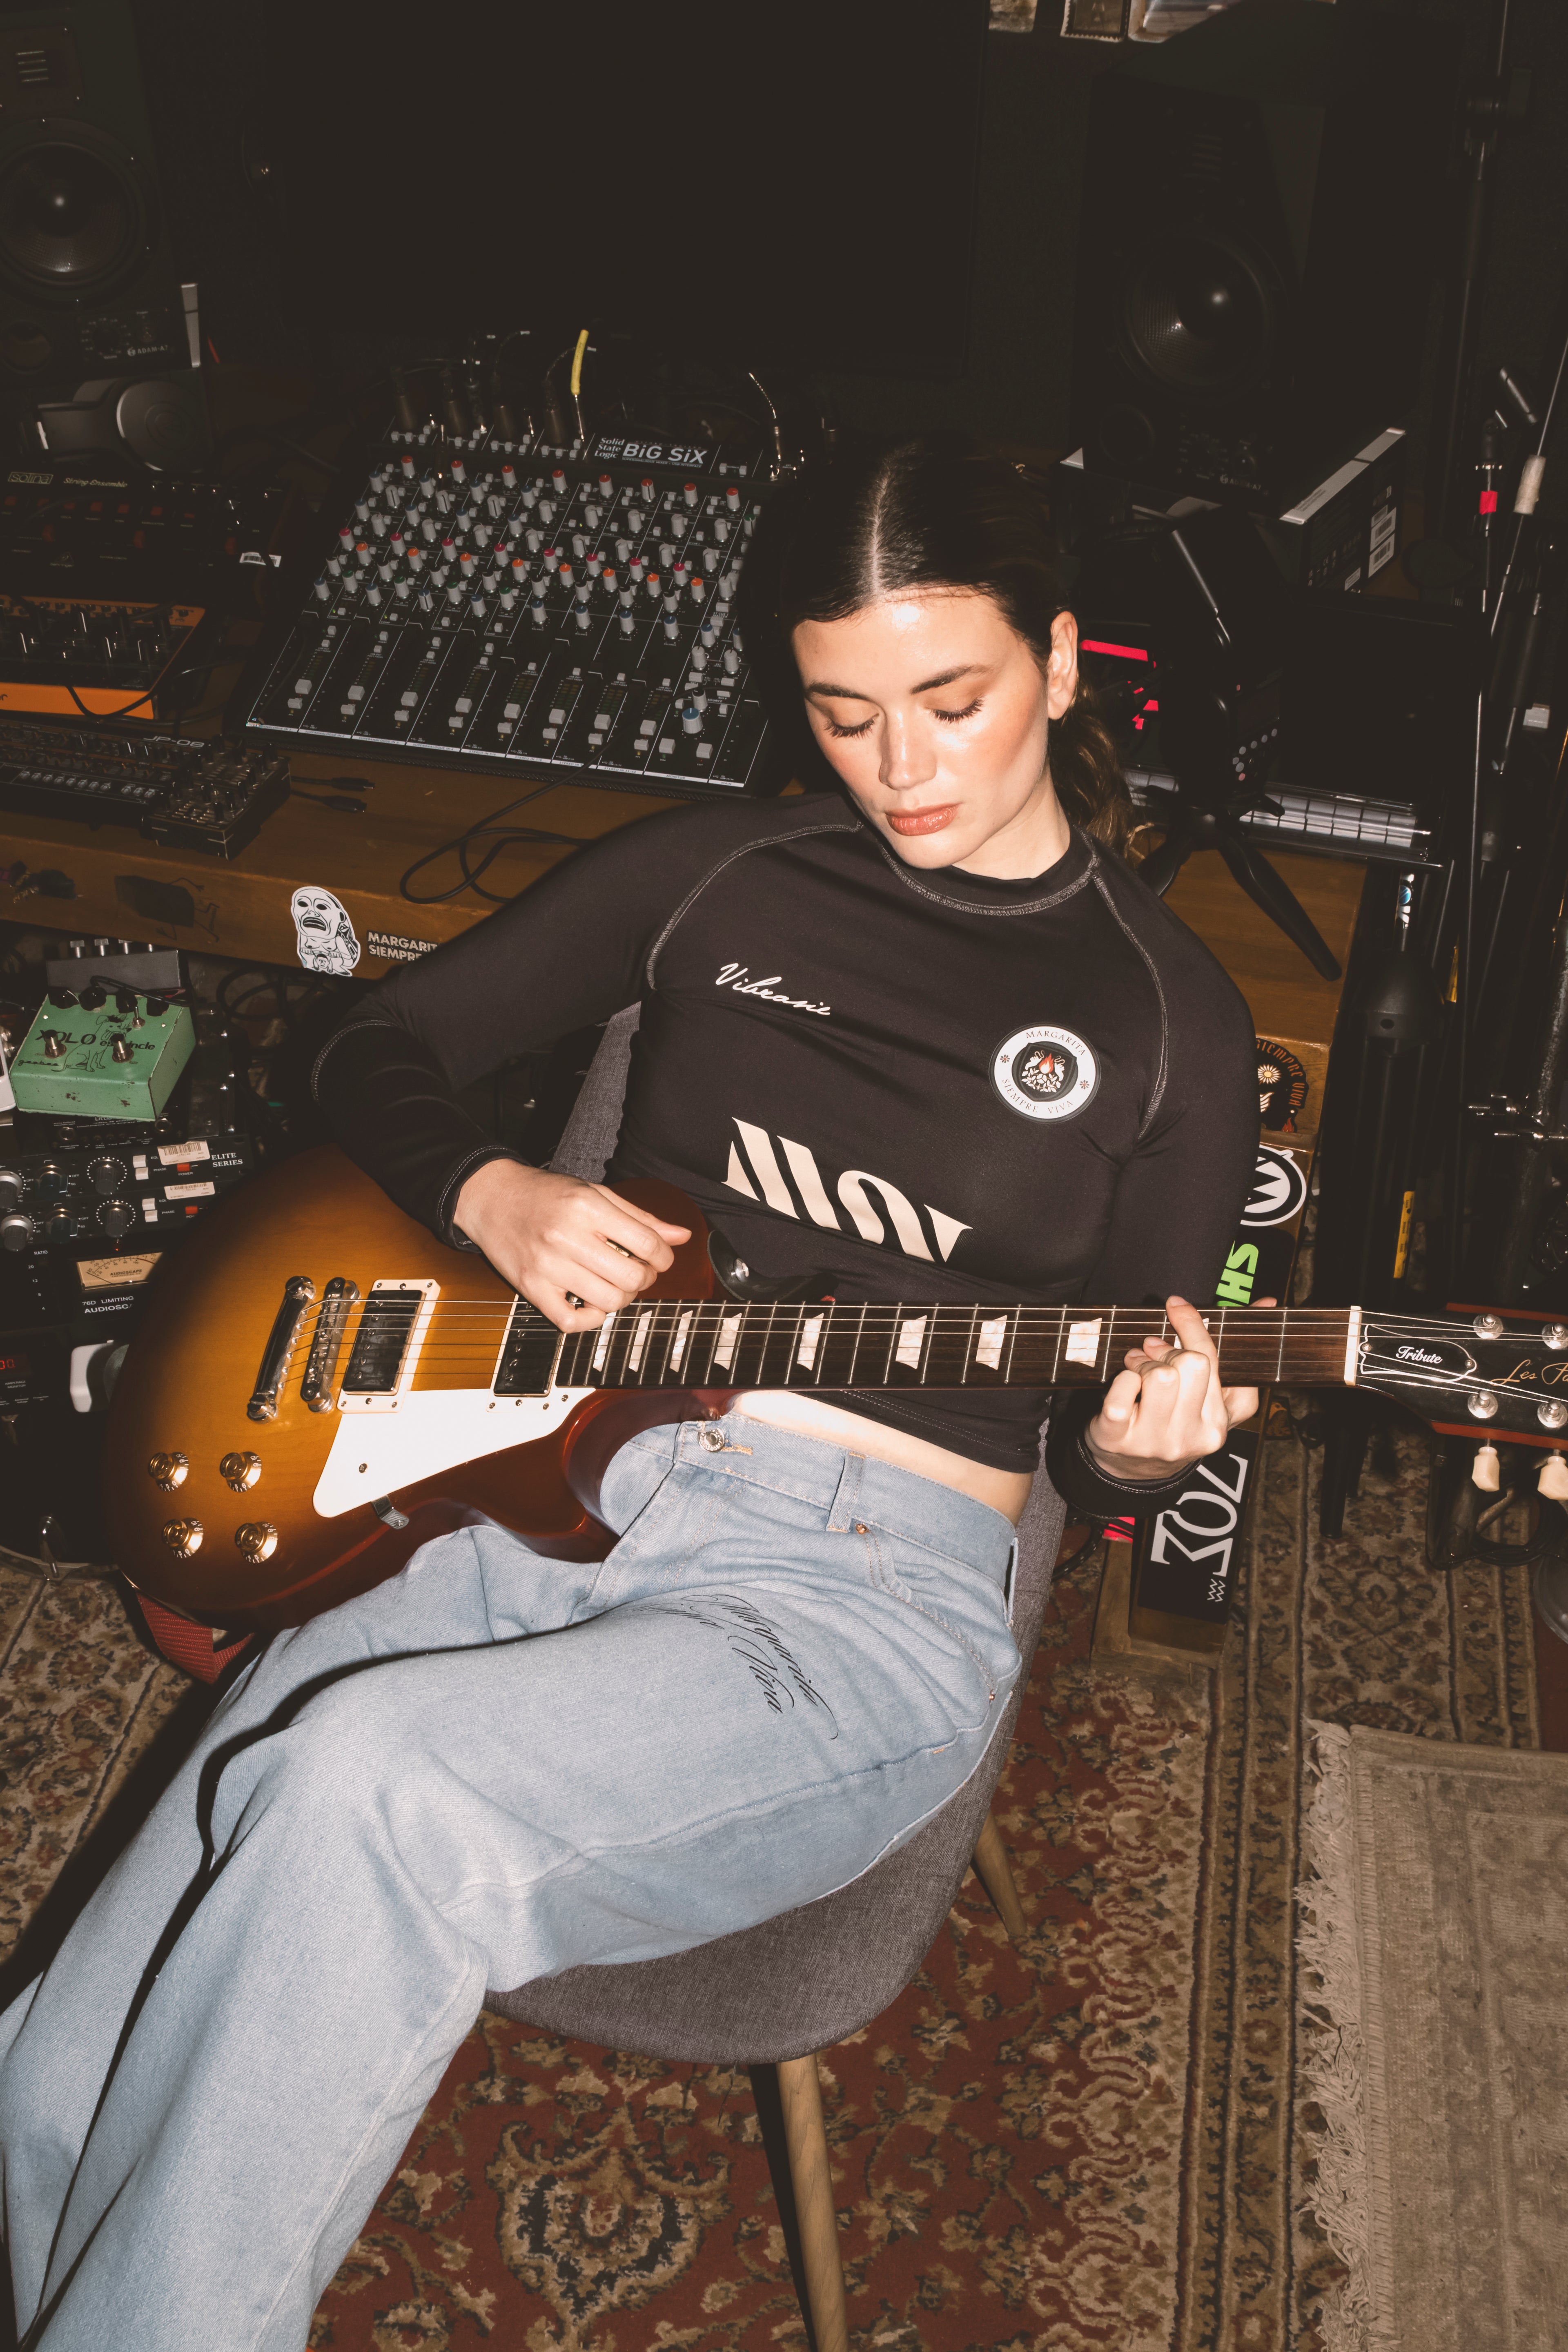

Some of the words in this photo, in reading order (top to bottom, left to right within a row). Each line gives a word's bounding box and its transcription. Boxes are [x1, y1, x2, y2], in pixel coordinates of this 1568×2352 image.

[597, 444, 621, 452] State
[600, 437, 625, 446] Solid
[594, 450, 619, 459] Logic
[622, 443, 663, 459] BiG
[667, 448, 708, 464] SiX
[143, 735, 205, 749] JP-08
[368, 931, 438, 952] MARGARIT
[1026, 1030, 1086, 1056] MARGARITA
[1002, 1079, 1038, 1113] SIEMPRE
[1047, 1100, 1073, 1114] VIVA
[211, 1152, 237, 1160] ELITE
[212, 1159, 243, 1168] SERIES
[101, 1296, 134, 1304] LIMITING
[84, 1304, 132, 1314] AUDIOSC
[1396, 1346, 1443, 1364] Tribute
[1490, 1359, 1537, 1386] Les
[727, 1635, 795, 1714] Viva
